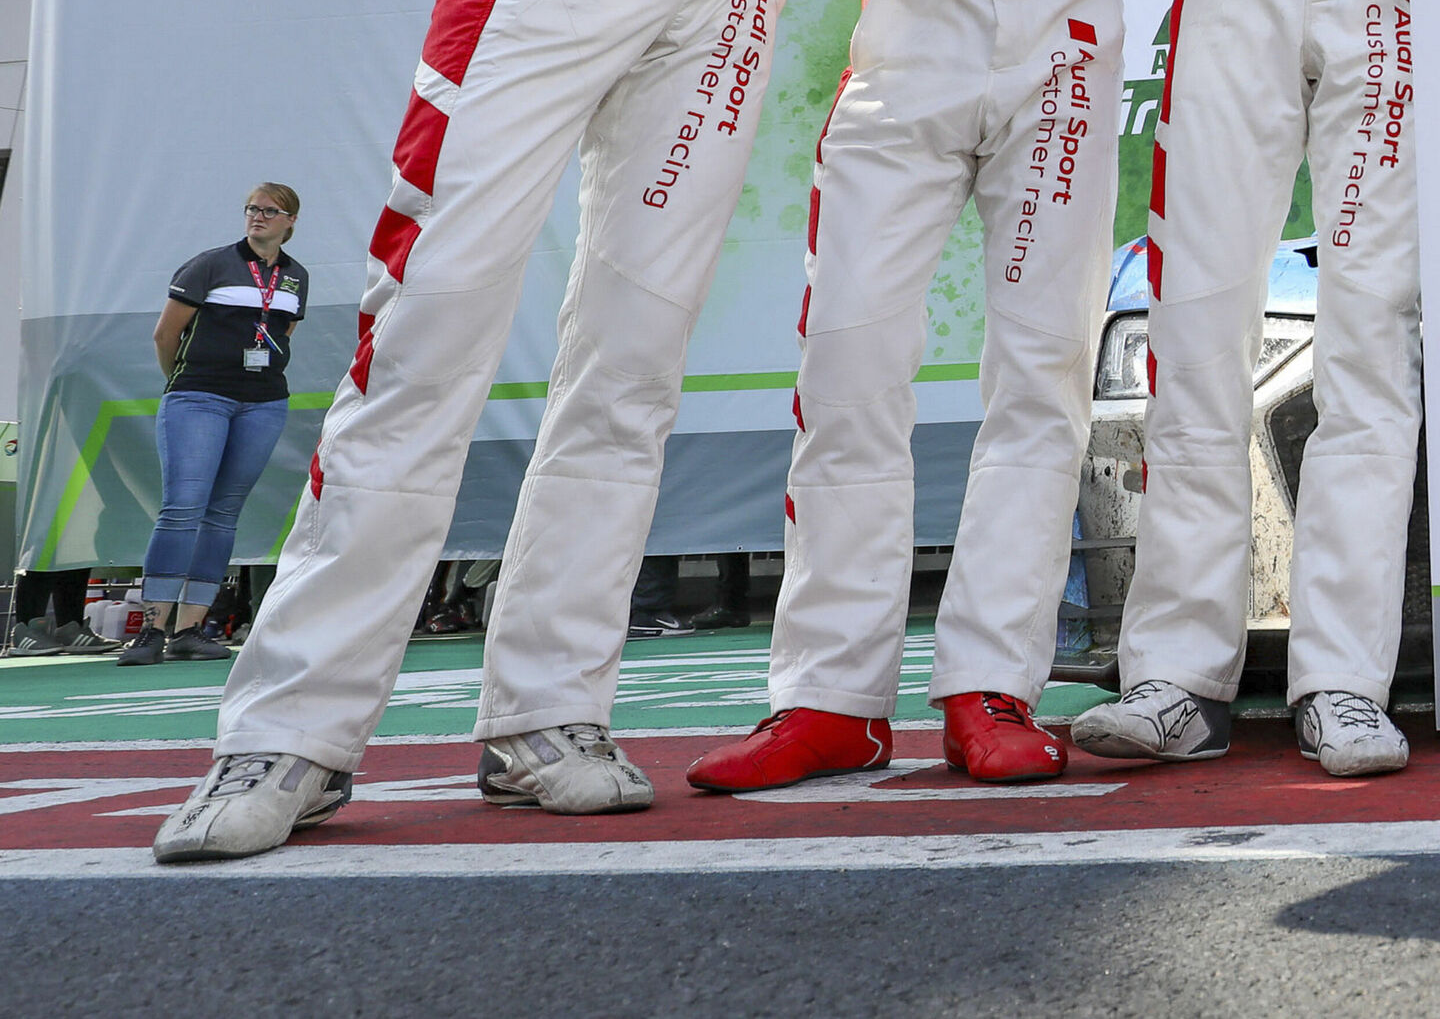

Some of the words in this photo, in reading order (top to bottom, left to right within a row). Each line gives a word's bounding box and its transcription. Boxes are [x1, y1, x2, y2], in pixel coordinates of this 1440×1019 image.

[1070, 48, 1095, 111] Audi
[1357, 4, 1388, 142] customer
[1393, 6, 1412, 74] Audi
[717, 46, 760, 136] Sport
[1030, 51, 1066, 179] customer
[1379, 83, 1414, 169] Sport
[642, 111, 705, 209] racing
[1052, 115, 1088, 206] Sport
[1332, 152, 1367, 248] racing
[1005, 186, 1040, 284] racing
